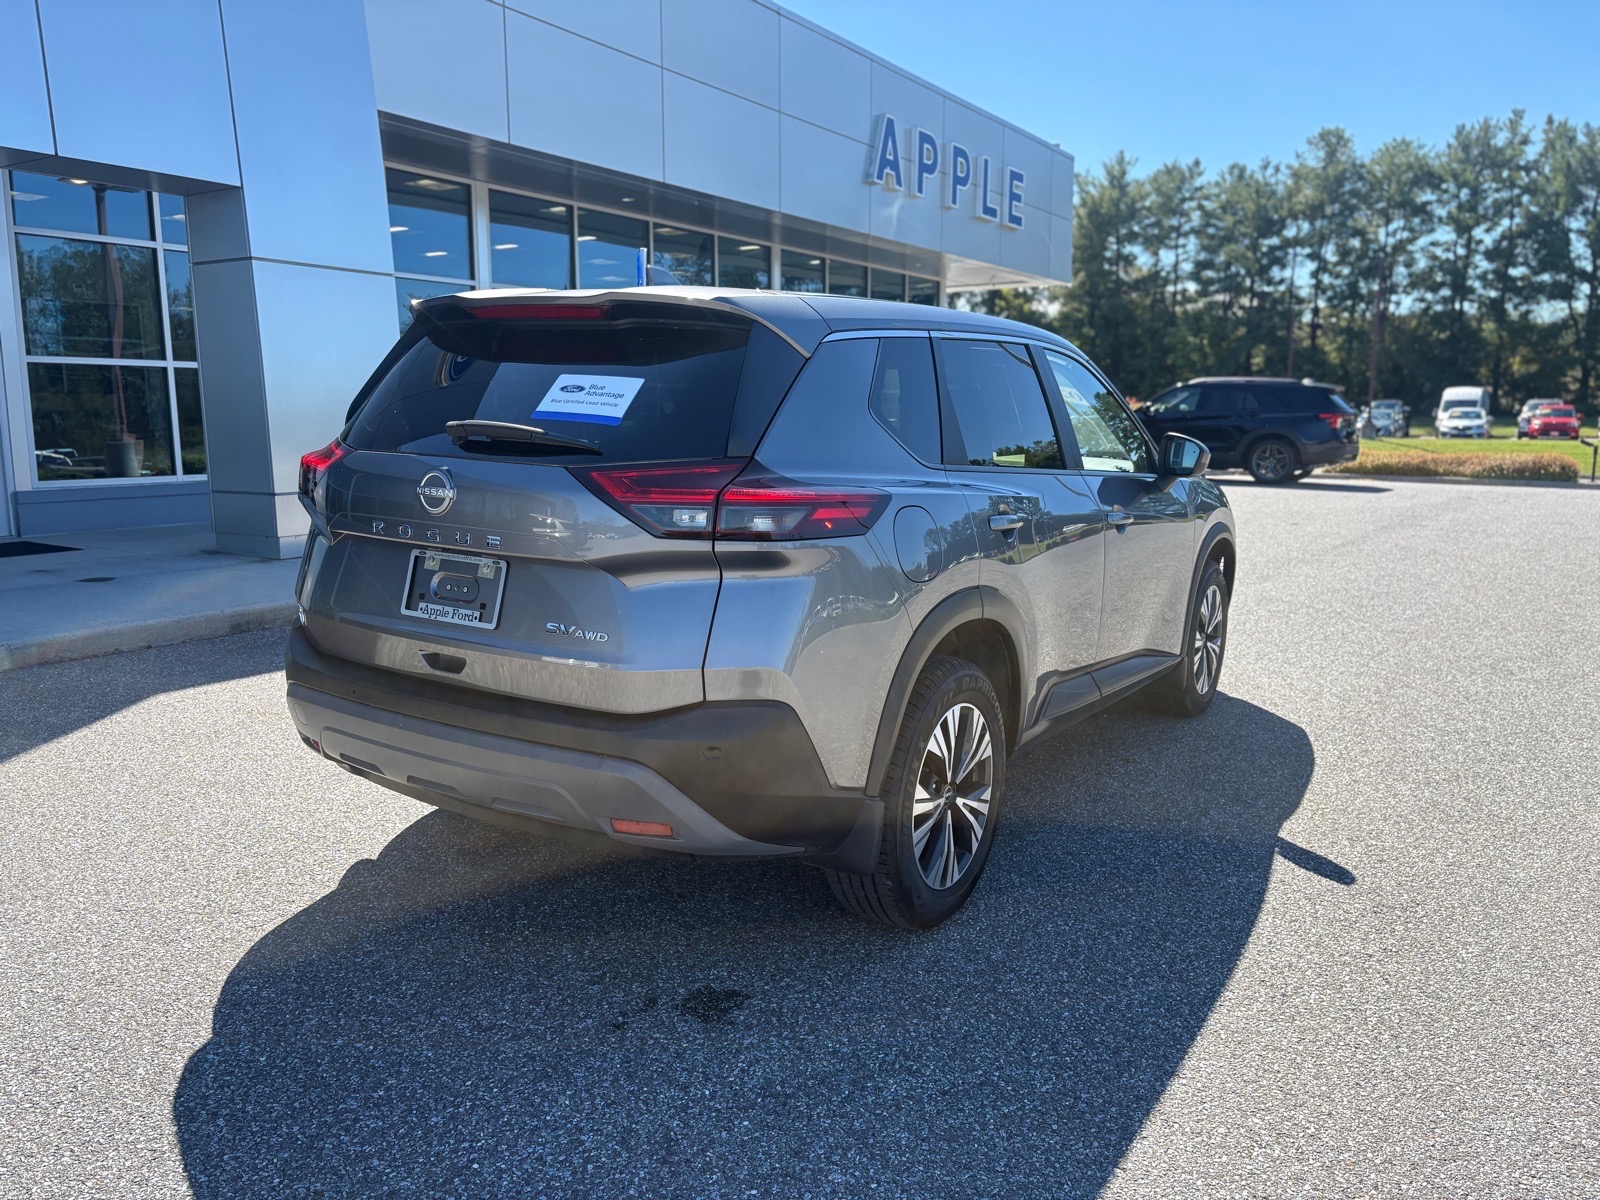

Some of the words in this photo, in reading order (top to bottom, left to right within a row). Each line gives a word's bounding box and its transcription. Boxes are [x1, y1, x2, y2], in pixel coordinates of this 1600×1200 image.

[869, 113, 1026, 229] APPLE
[561, 385, 584, 393] Ford
[584, 390, 625, 399] Advantage
[416, 486, 453, 498] NISSAN
[372, 520, 502, 549] ROGUE
[422, 604, 450, 619] Apple
[451, 608, 475, 622] Ford
